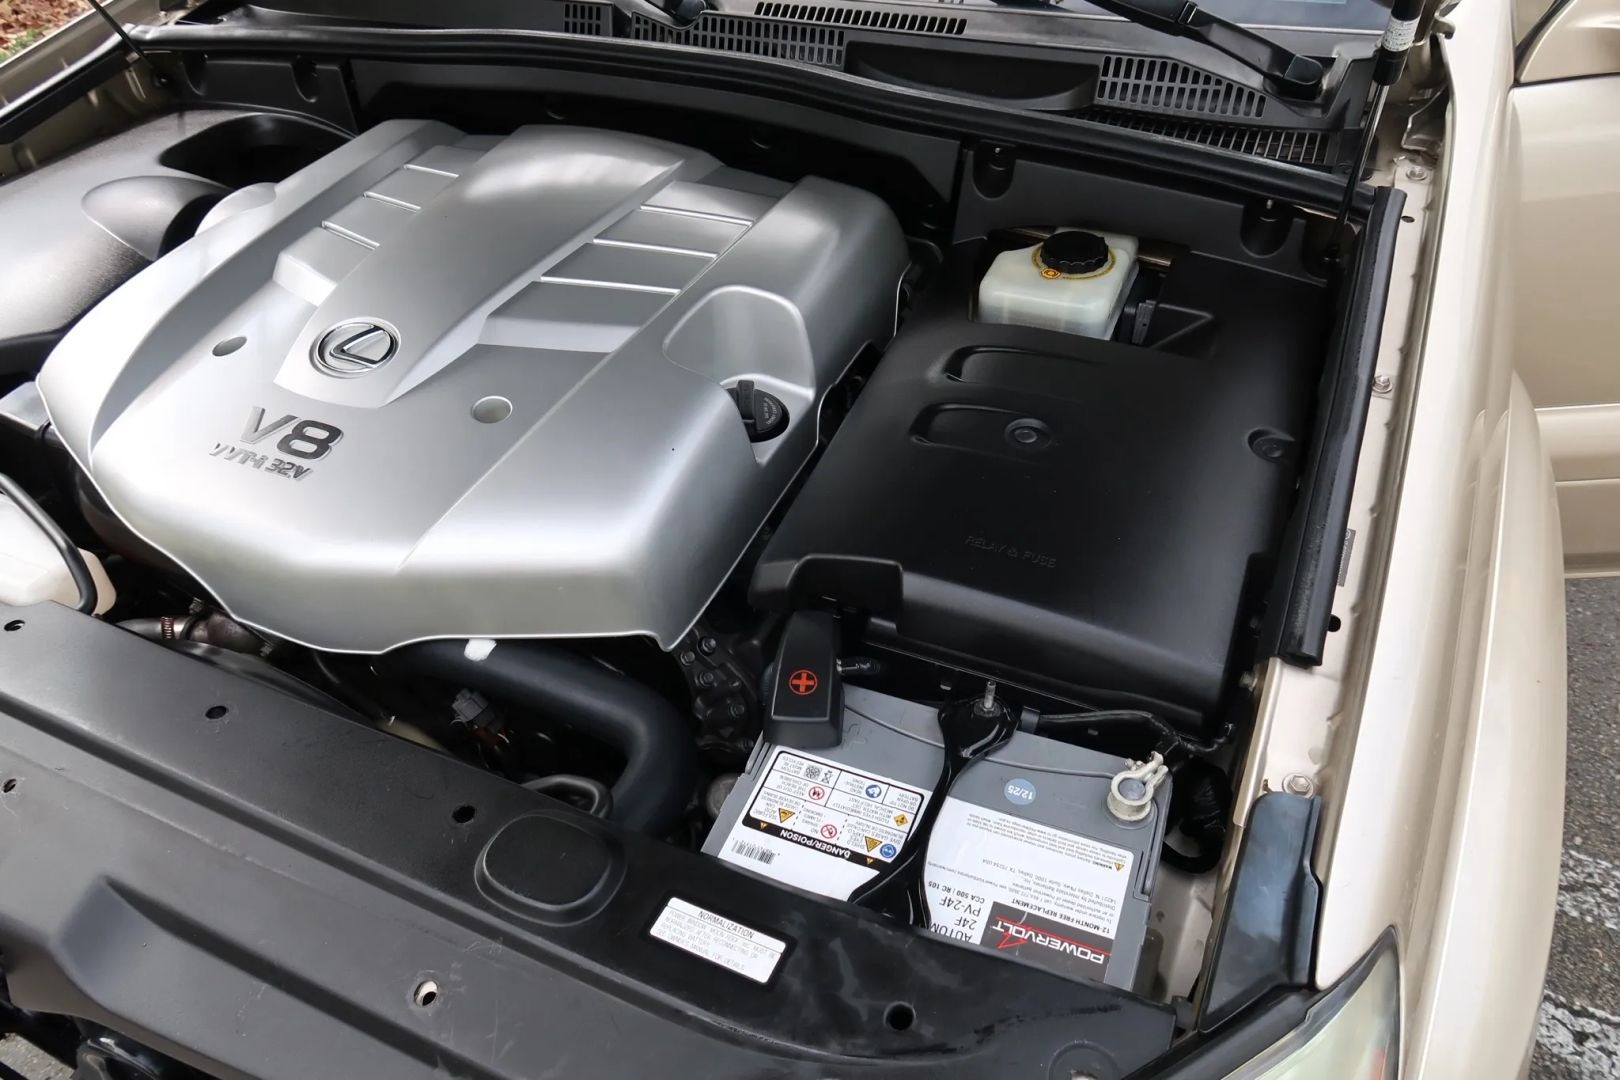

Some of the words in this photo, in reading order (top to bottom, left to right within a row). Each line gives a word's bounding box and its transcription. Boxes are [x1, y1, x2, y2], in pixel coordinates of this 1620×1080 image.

[240, 405, 344, 460] V8
[265, 458, 314, 481] 32V
[1006, 784, 1034, 800] 12/25
[778, 829, 851, 858] DANGER/POISON
[927, 881, 940, 889] 105
[941, 885, 951, 893] RC
[955, 890, 969, 898] 500
[970, 894, 985, 903] CCA
[938, 894, 982, 916] PV-24F
[1011, 897, 1058, 916] REPLACEMENT
[696, 910, 755, 939] NORMALIZATION
[953, 914, 977, 930] 24F
[1058, 912, 1074, 922] FREE
[1075, 918, 1110, 933] 12-MONTH
[991, 919, 1106, 963] POWERVOLT
